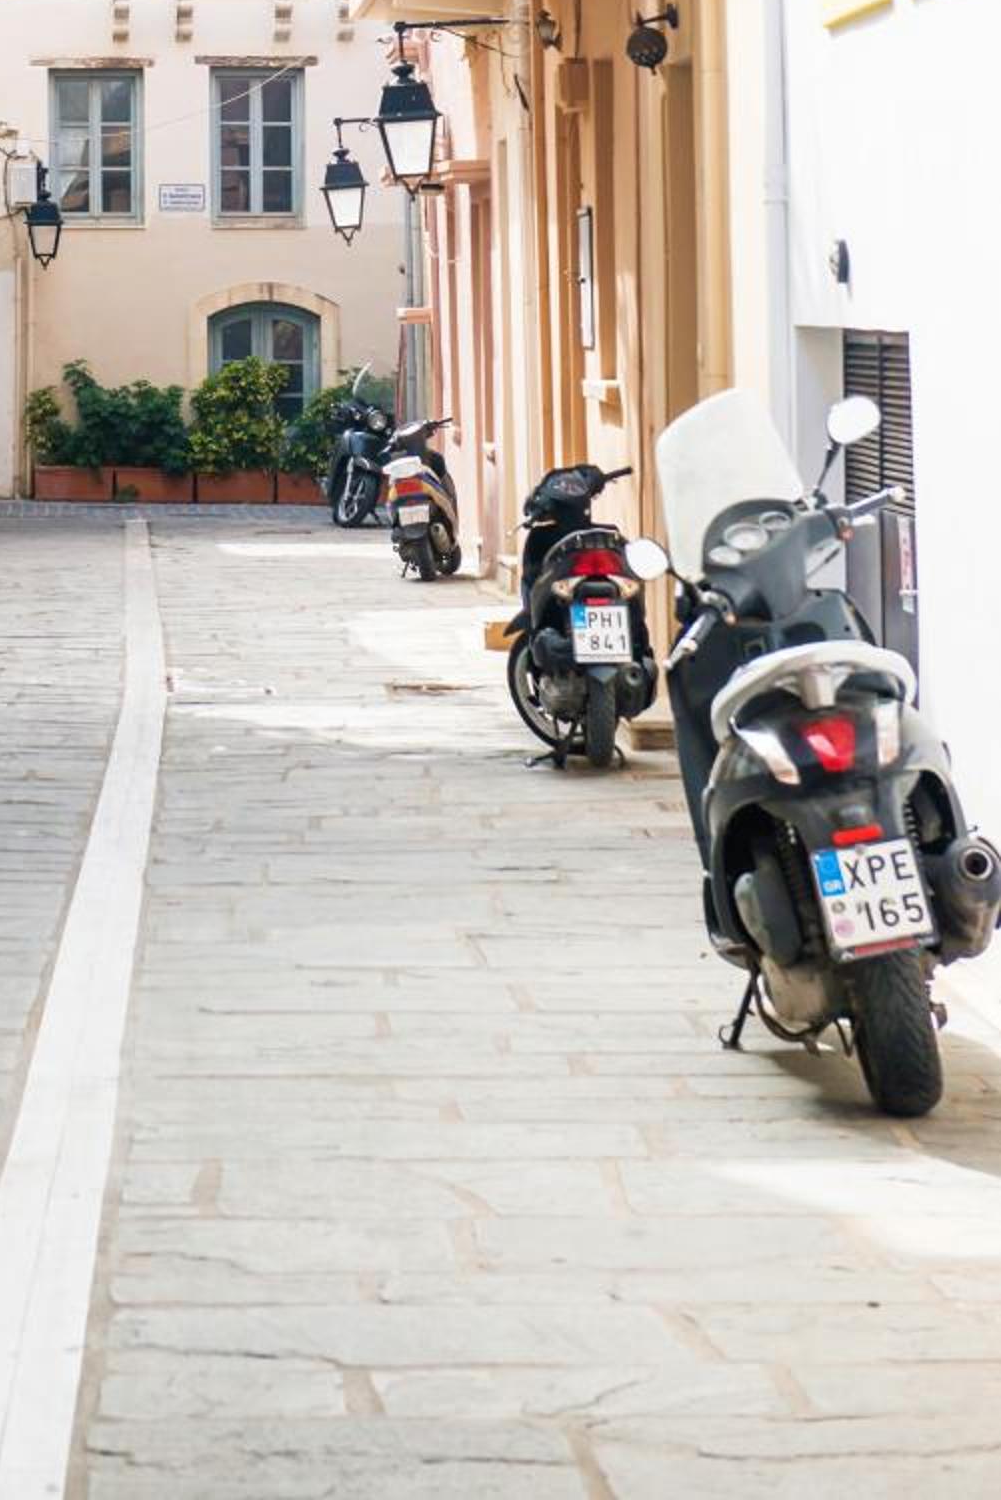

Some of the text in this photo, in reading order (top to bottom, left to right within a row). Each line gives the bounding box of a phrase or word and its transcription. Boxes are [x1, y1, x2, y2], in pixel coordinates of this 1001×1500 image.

[588, 611, 622, 628] PHI
[590, 634, 626, 650] 841
[844, 850, 914, 889] XPE
[858, 893, 924, 930] 165
